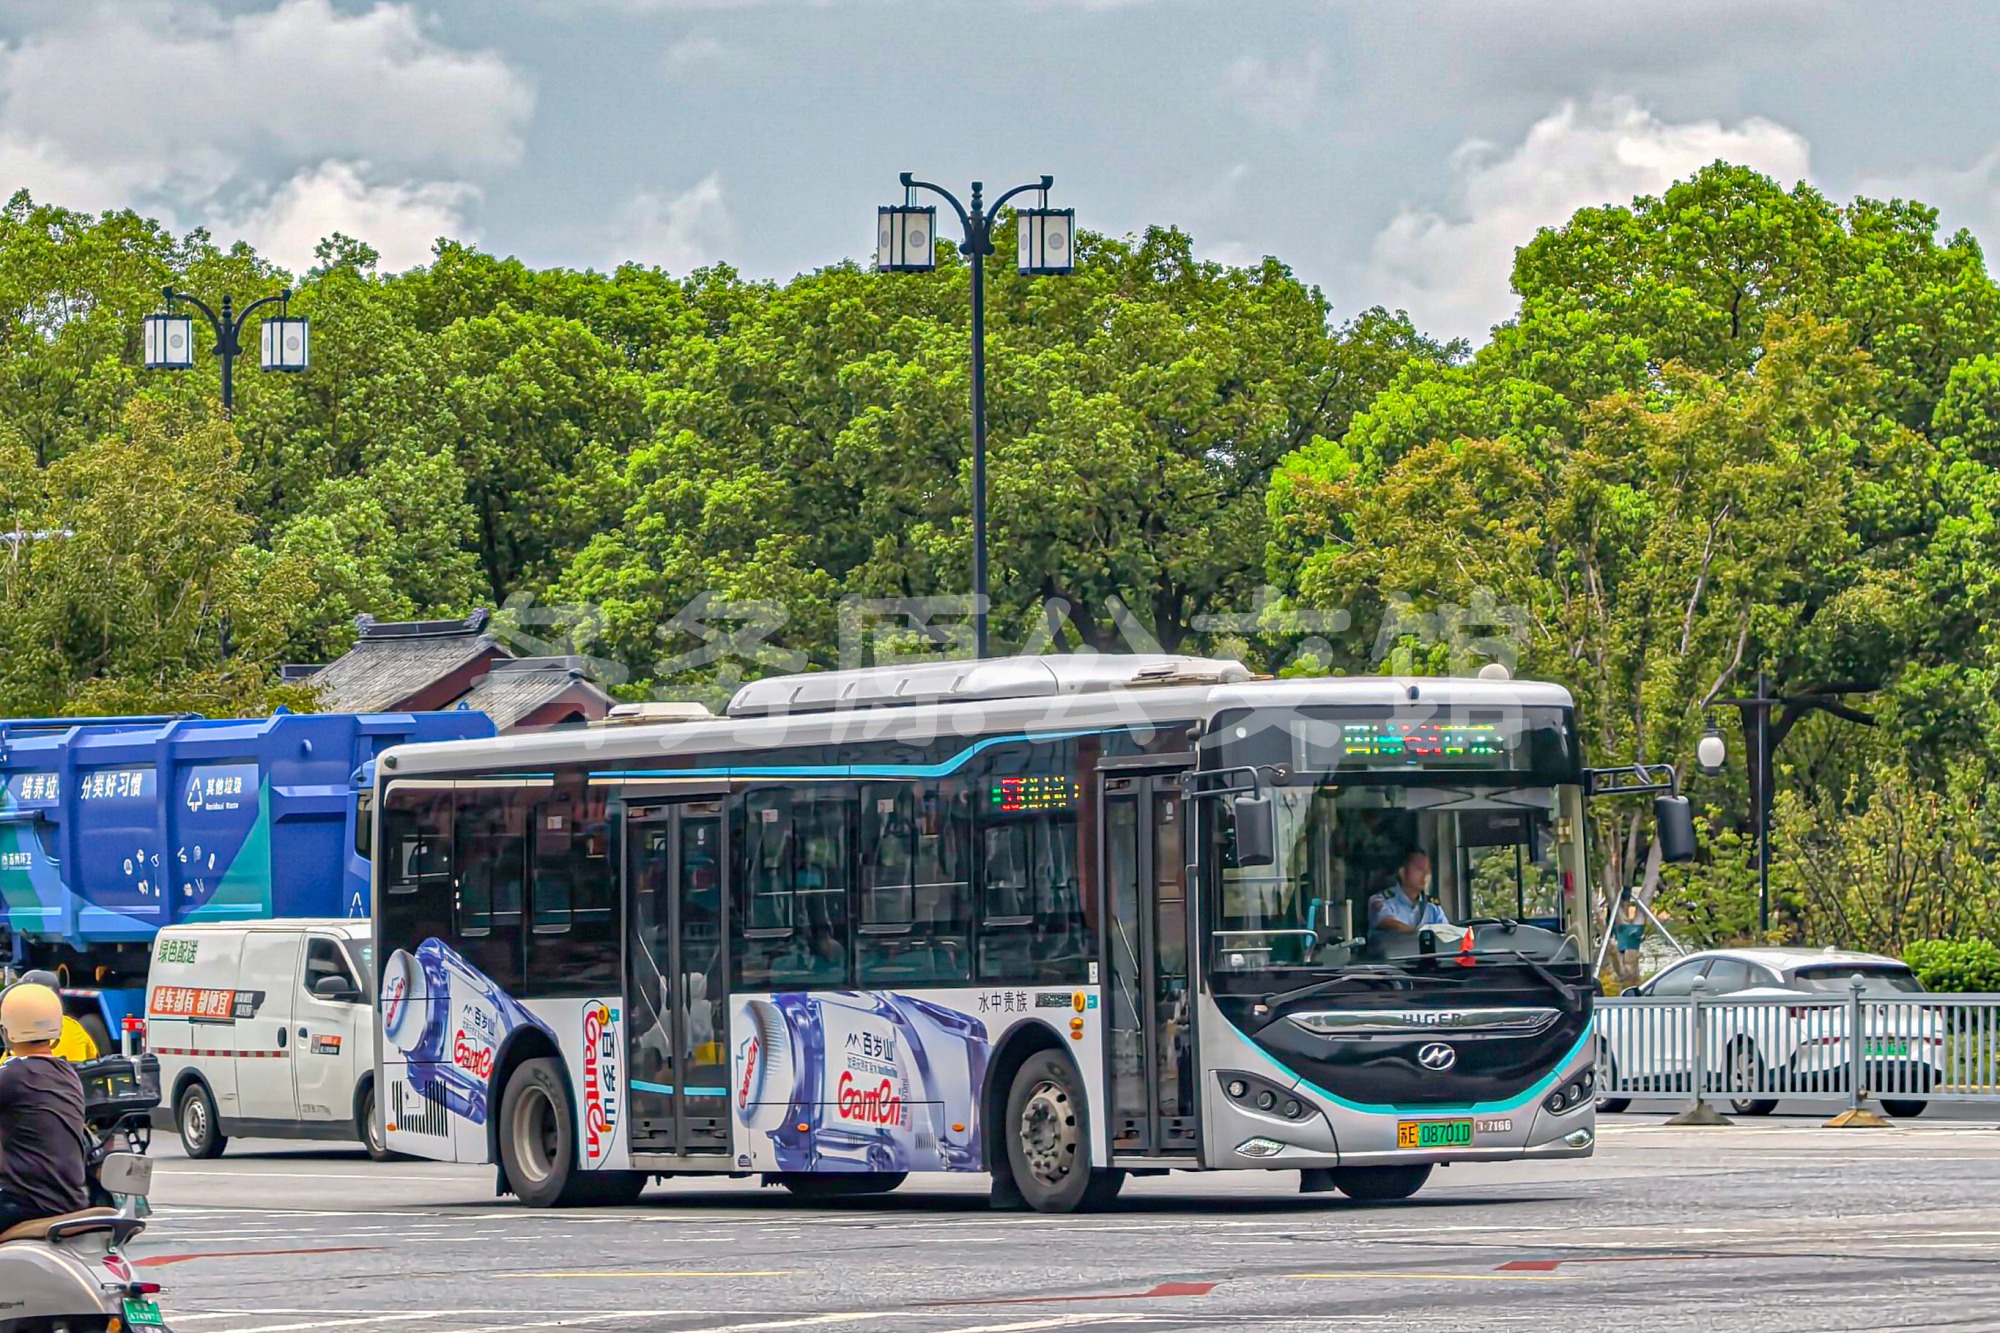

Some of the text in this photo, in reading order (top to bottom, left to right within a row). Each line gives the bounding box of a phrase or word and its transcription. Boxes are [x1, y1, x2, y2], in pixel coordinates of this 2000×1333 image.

[21, 772, 143, 800] 培养垃 分类好习惯
[206, 776, 242, 796] 其他垃圾
[157, 940, 198, 964] 绿色配送
[978, 990, 1028, 1013] 水中贵族
[474, 1006, 495, 1036] 百岁山
[1403, 1013, 1463, 1027] HIGER
[862, 1031, 893, 1062] 百岁山
[584, 1010, 606, 1158] Ganten
[602, 1031, 616, 1125] 百岁山
[837, 1070, 901, 1126] Ganten
